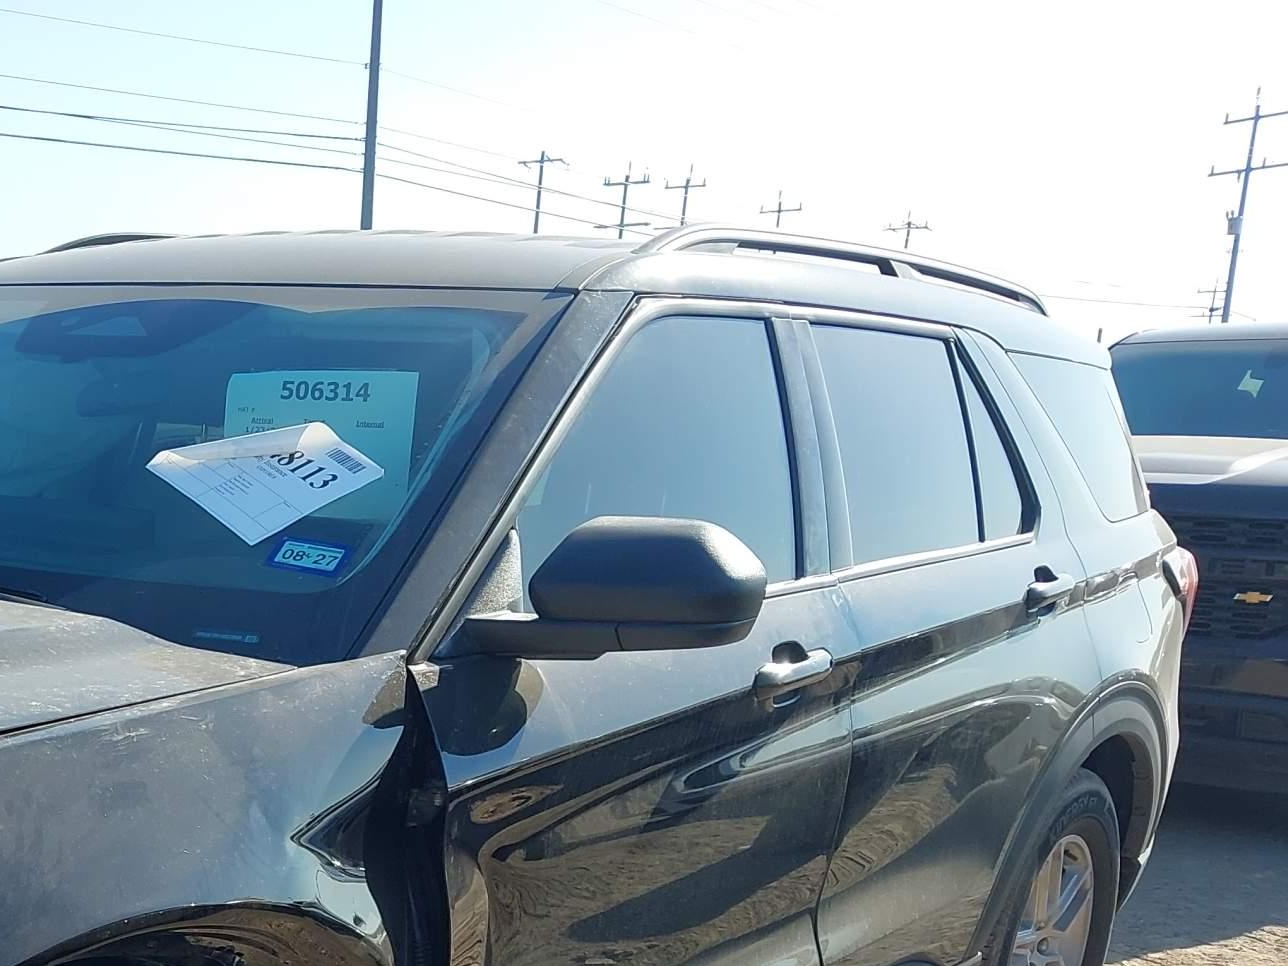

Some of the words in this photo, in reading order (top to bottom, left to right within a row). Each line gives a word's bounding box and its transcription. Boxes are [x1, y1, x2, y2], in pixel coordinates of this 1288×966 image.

[279, 380, 371, 402] 506314
[269, 449, 339, 490] 8113
[281, 548, 306, 562] 08
[312, 553, 339, 567] 27
